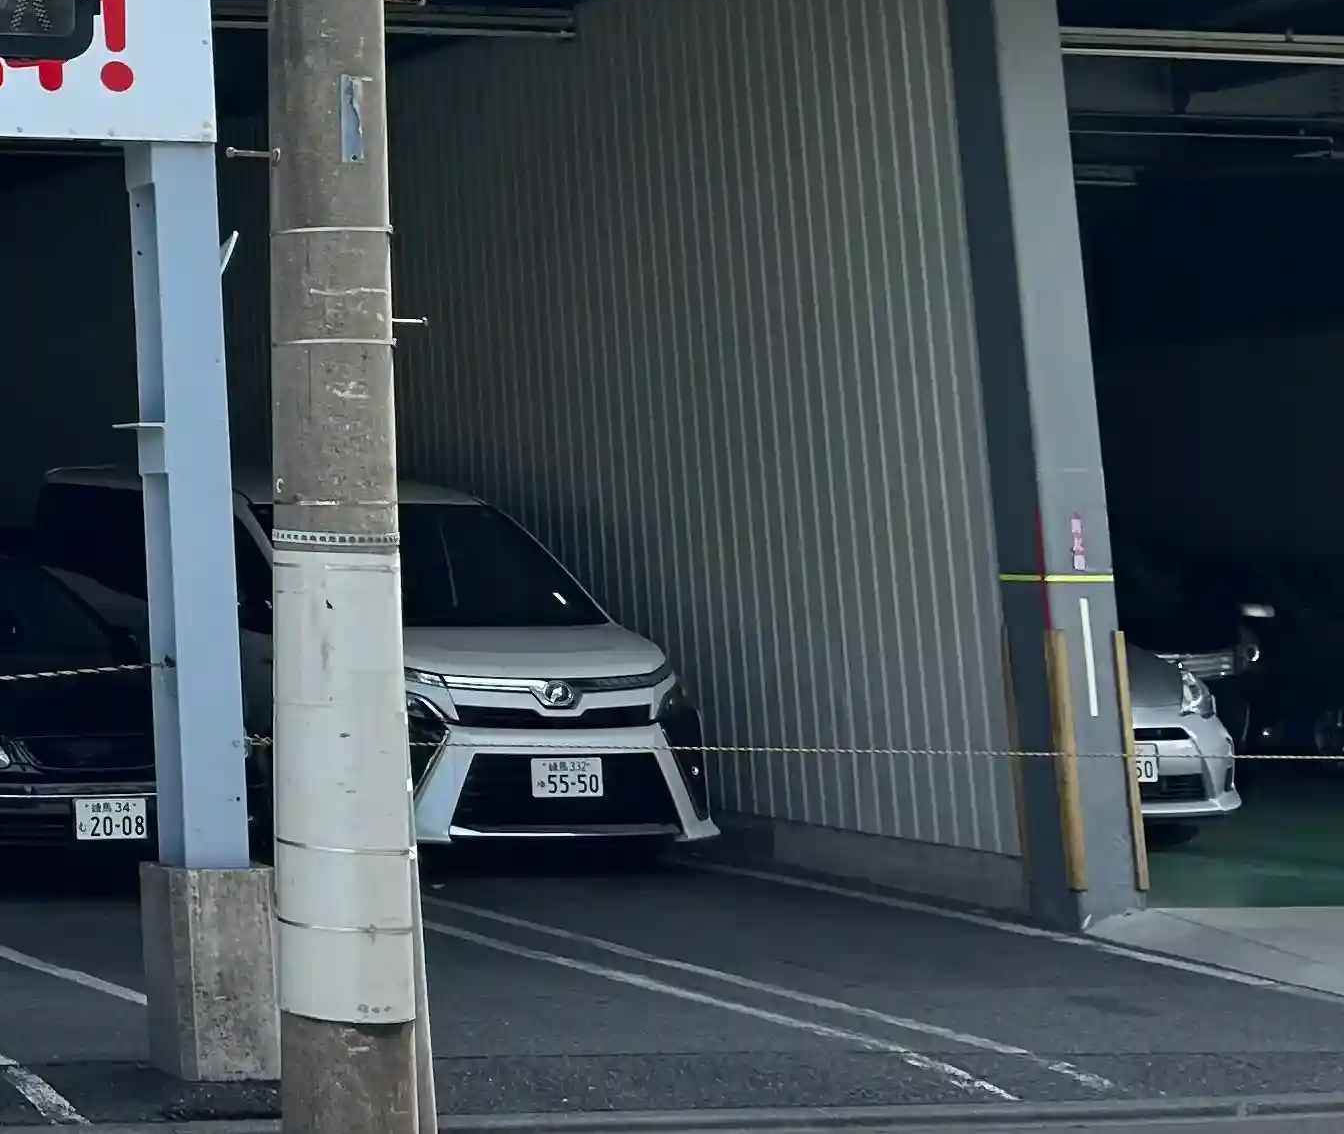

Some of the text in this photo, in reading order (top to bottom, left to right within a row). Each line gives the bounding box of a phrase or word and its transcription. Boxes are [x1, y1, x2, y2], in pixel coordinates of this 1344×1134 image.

[548, 774, 599, 793] 55-50
[115, 802, 130, 812] 34
[91, 816, 144, 836] 20-08
